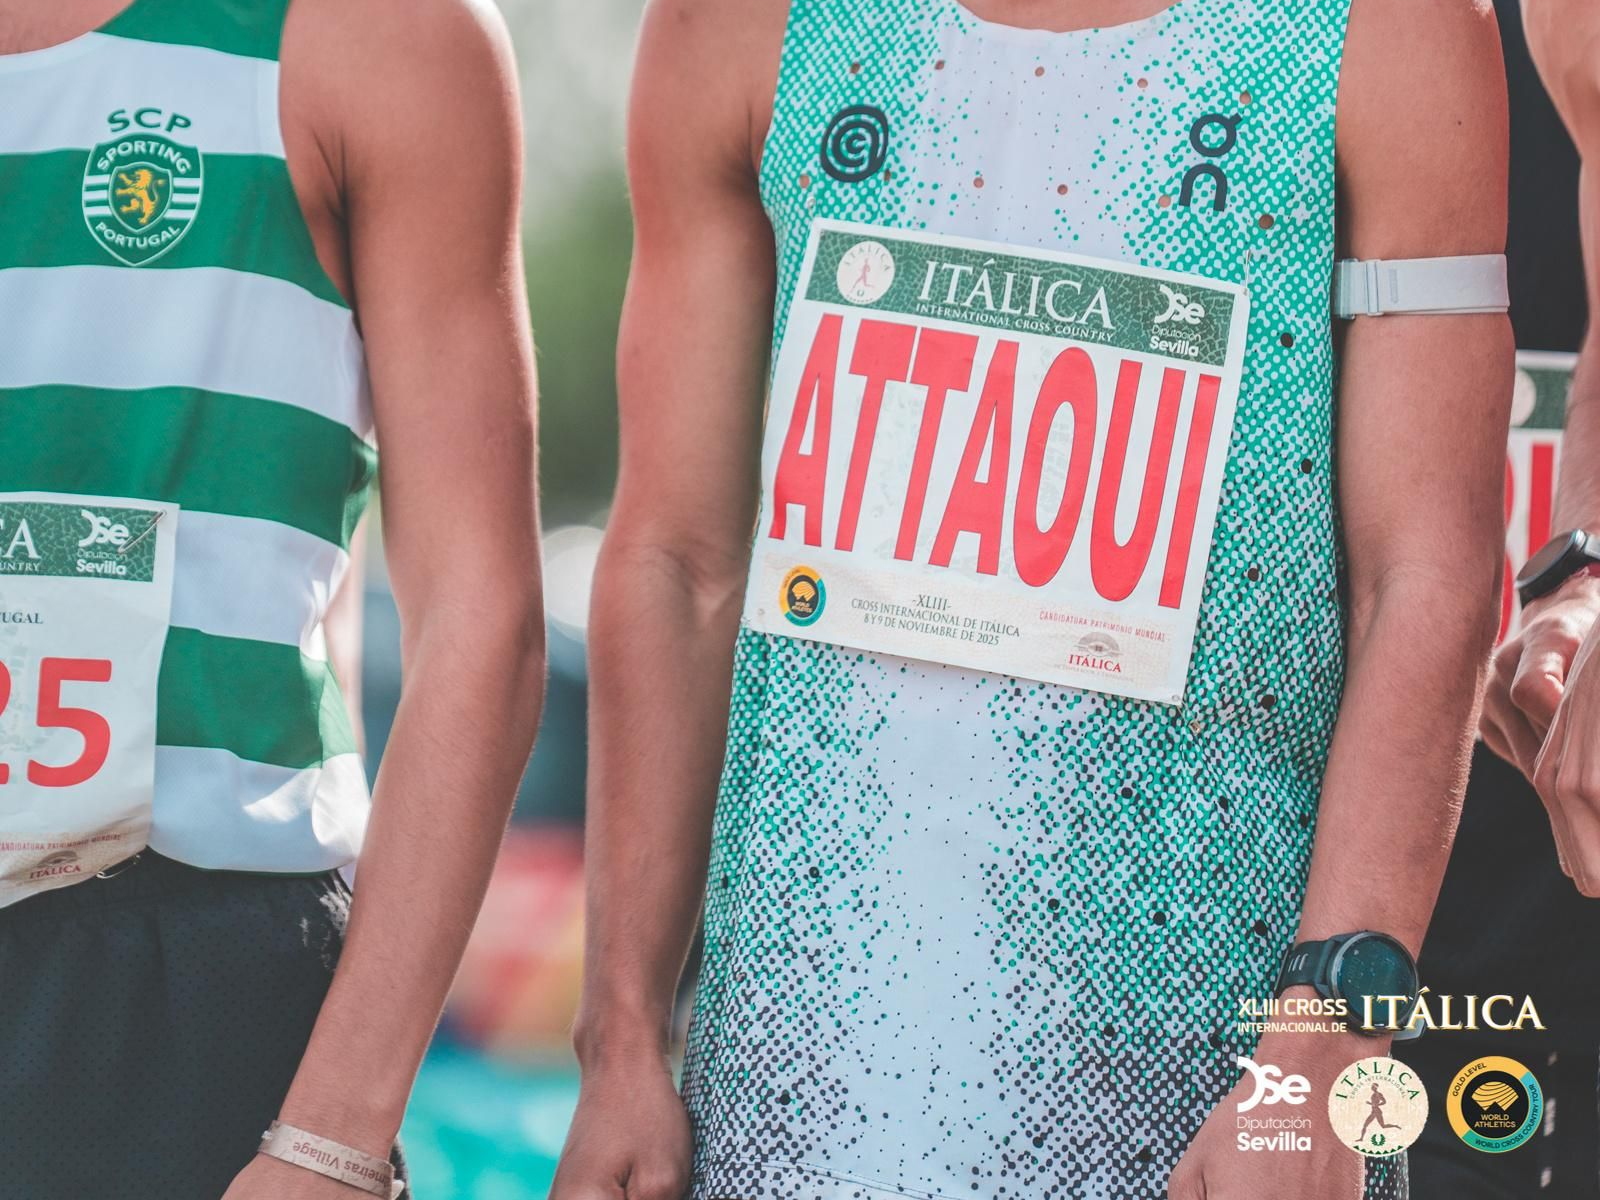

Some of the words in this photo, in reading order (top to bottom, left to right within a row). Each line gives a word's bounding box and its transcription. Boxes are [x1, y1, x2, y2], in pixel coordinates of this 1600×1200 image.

[107, 107, 192, 133] SCP
[97, 140, 192, 174] SPORTING
[95, 222, 181, 248] PORTUGAL
[917, 257, 1116, 330] ITÁLICA
[916, 302, 1010, 327] INTERNATIONAL
[1015, 317, 1051, 333] CROSS
[1054, 325, 1115, 343] COUNTRY
[1149, 335, 1200, 358] Sevilla
[768, 312, 1222, 609] ATTAOUI
[0, 518, 41, 559] A
[76, 558, 127, 576] Sevilla
[0, 611, 43, 624] UGAL
[851, 598, 878, 612] CROSS
[880, 603, 960, 626] INTERNACIONAL
[963, 617, 978, 629] DE
[980, 619, 1020, 637] ITÁLICA
[864, 613, 870, 623] 8
[871, 613, 877, 624] Y
[878, 615, 883, 625] 9
[884, 616, 896, 628] DE
[898, 618, 958, 639] NOVIEMBRE
[960, 630, 975, 642] DE
[977, 632, 1000, 645] 2025
[1039, 610, 1088, 626] CANDIDATURA
[1135, 628, 1166, 642] MUNDIAL
[293, 1141, 339, 1170] Village
